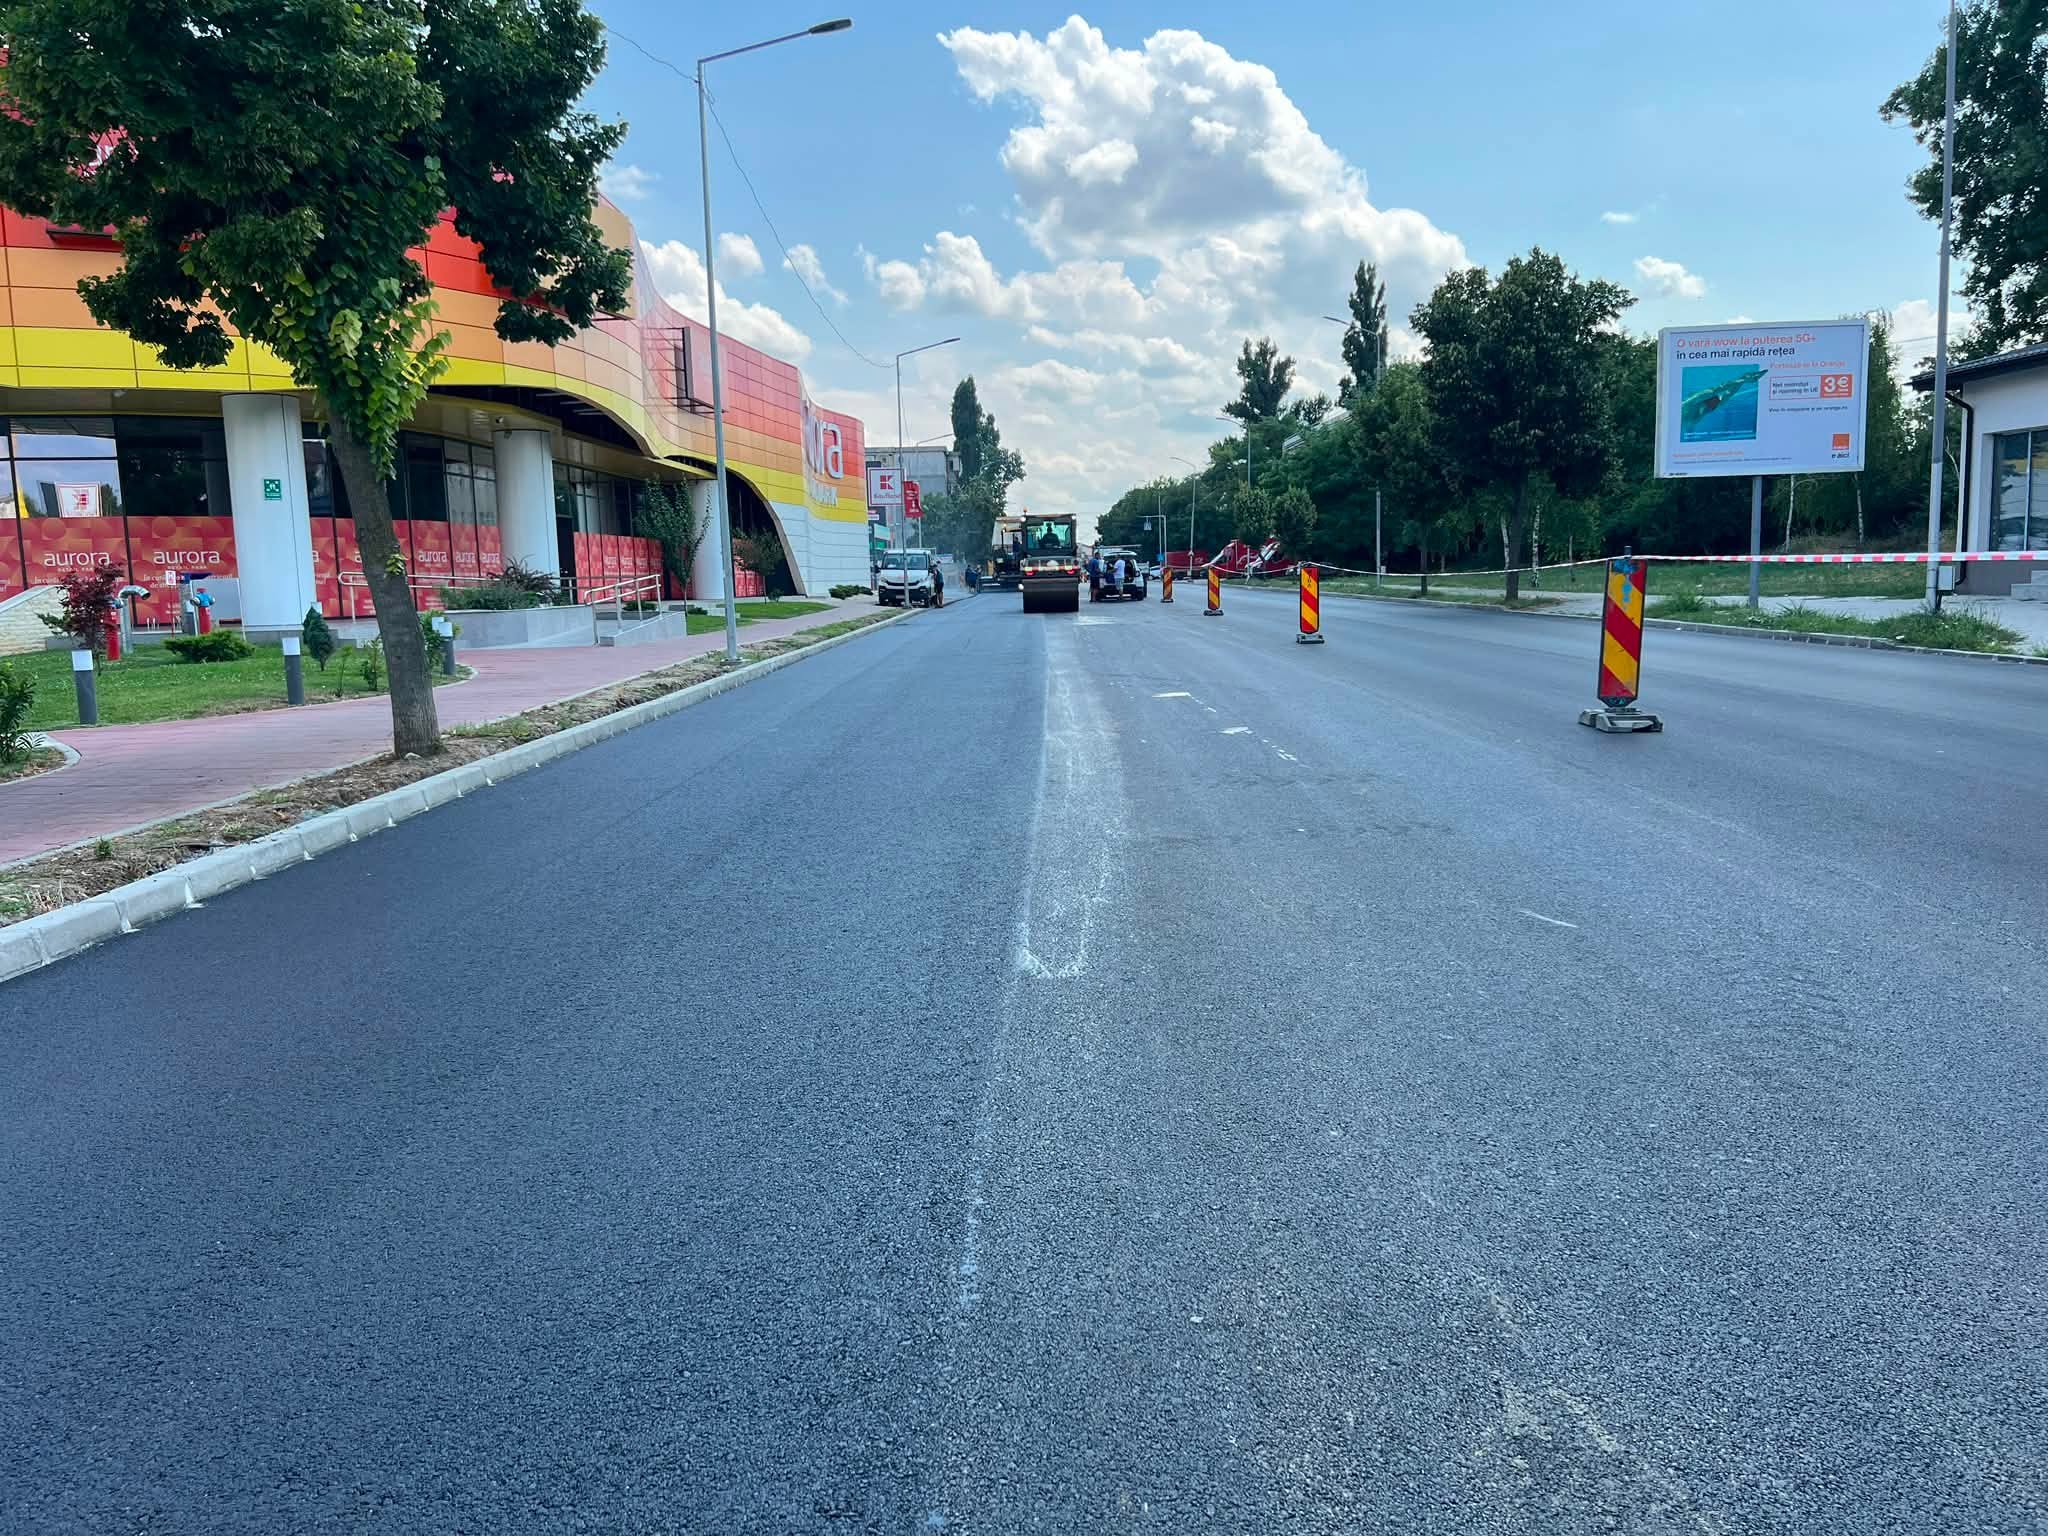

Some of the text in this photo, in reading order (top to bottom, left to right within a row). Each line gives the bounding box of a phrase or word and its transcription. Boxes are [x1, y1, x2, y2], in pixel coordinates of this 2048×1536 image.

[1677, 338, 1685, 348] O
[1714, 338, 1738, 346] wow
[1741, 335, 1750, 345] la
[1752, 334, 1793, 347] puterea
[1688, 351, 1707, 359] cea
[1710, 348, 1729, 358] mai
[43, 551, 112, 568] aurora
[153, 550, 221, 565] aurora
[418, 550, 449, 564] aurora
